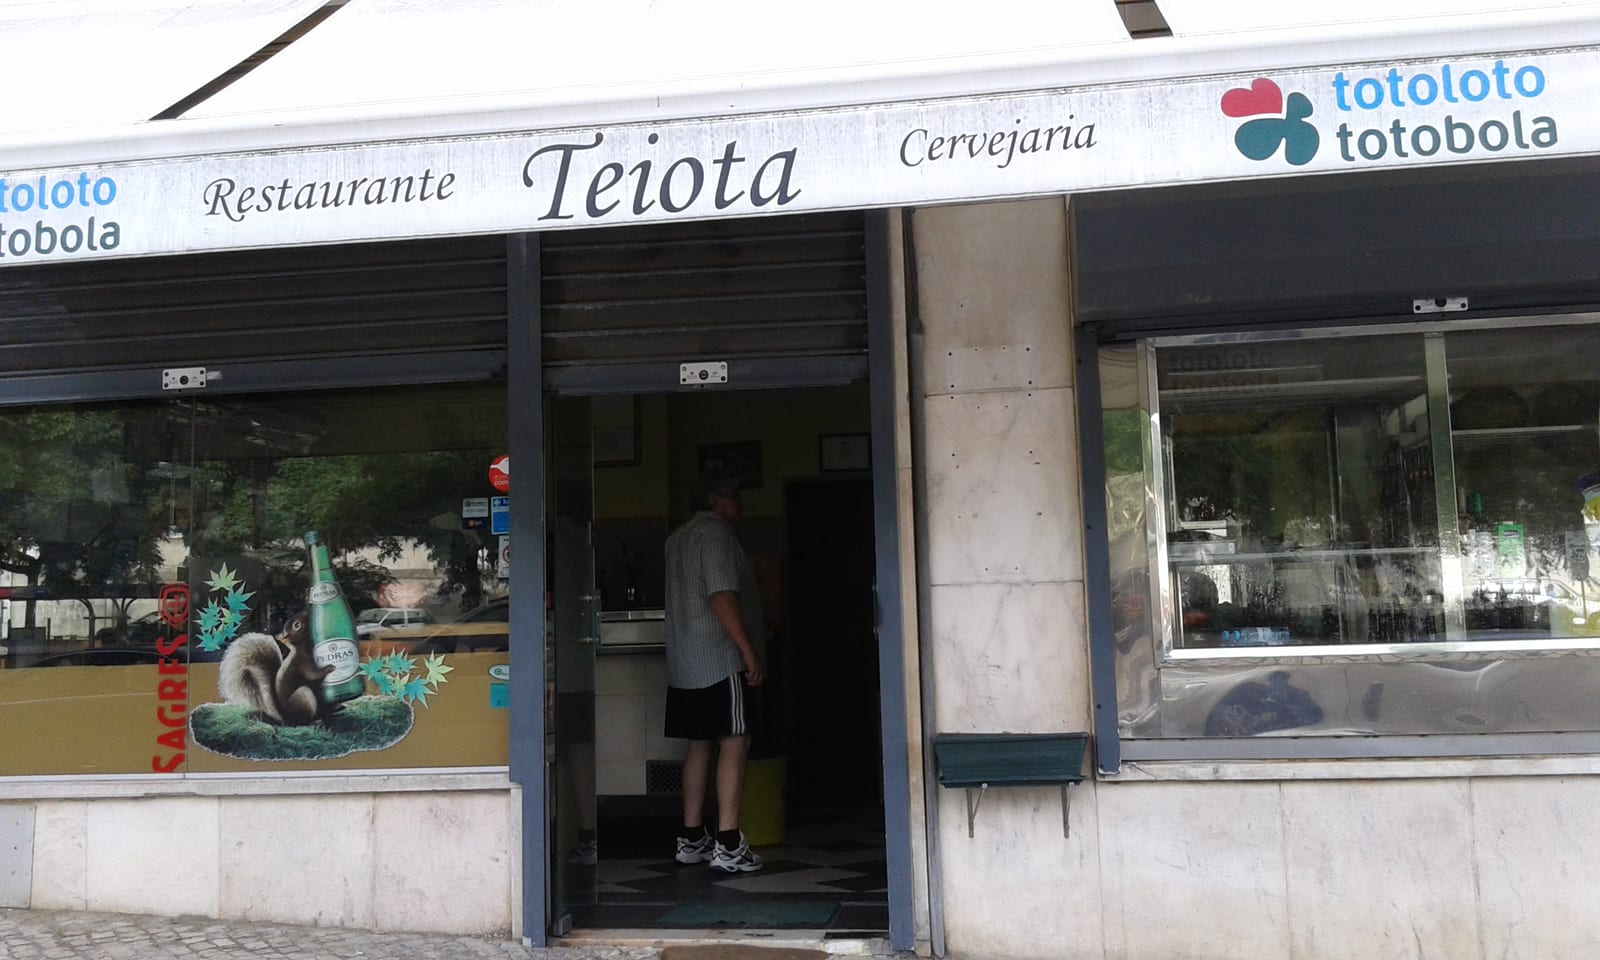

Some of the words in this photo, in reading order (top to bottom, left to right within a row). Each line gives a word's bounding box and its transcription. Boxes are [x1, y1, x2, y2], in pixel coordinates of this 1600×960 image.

[1332, 60, 1546, 112] totoloto
[899, 113, 1098, 169] Cervejaria
[1336, 110, 1558, 162] totobola
[203, 168, 456, 222] Restaurante
[522, 132, 803, 221] Teiota
[316, 650, 354, 663] PEDRAS
[152, 634, 189, 774] SAGRES
